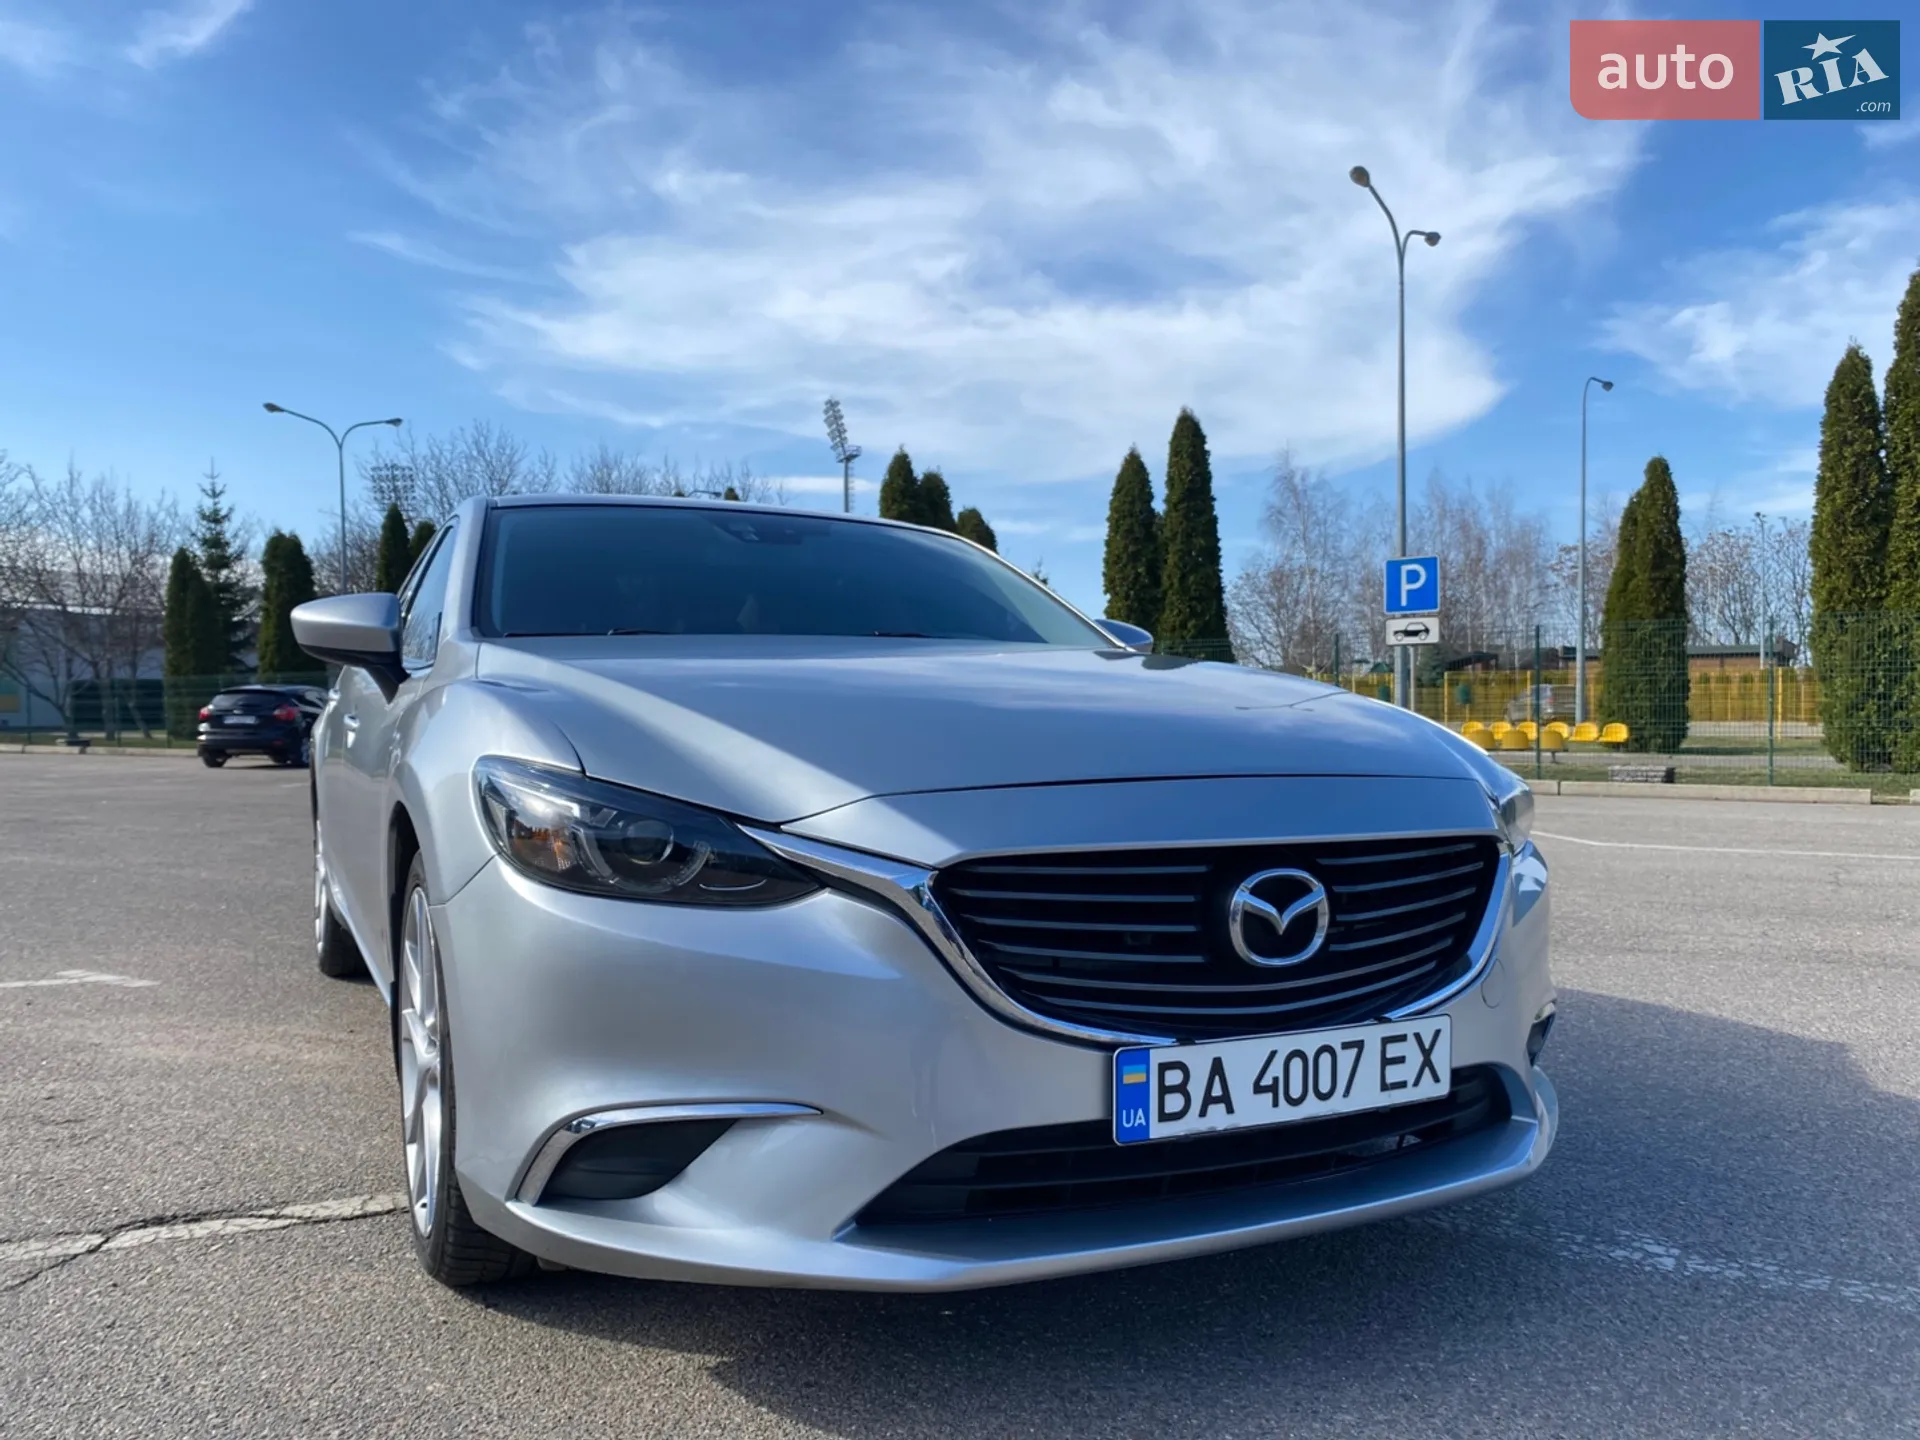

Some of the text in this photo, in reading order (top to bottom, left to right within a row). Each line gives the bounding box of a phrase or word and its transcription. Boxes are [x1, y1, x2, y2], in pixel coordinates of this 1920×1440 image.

[1400, 563, 1427, 607] P
[1157, 1028, 1443, 1124] BA 4007 EX
[1122, 1107, 1147, 1129] UA
